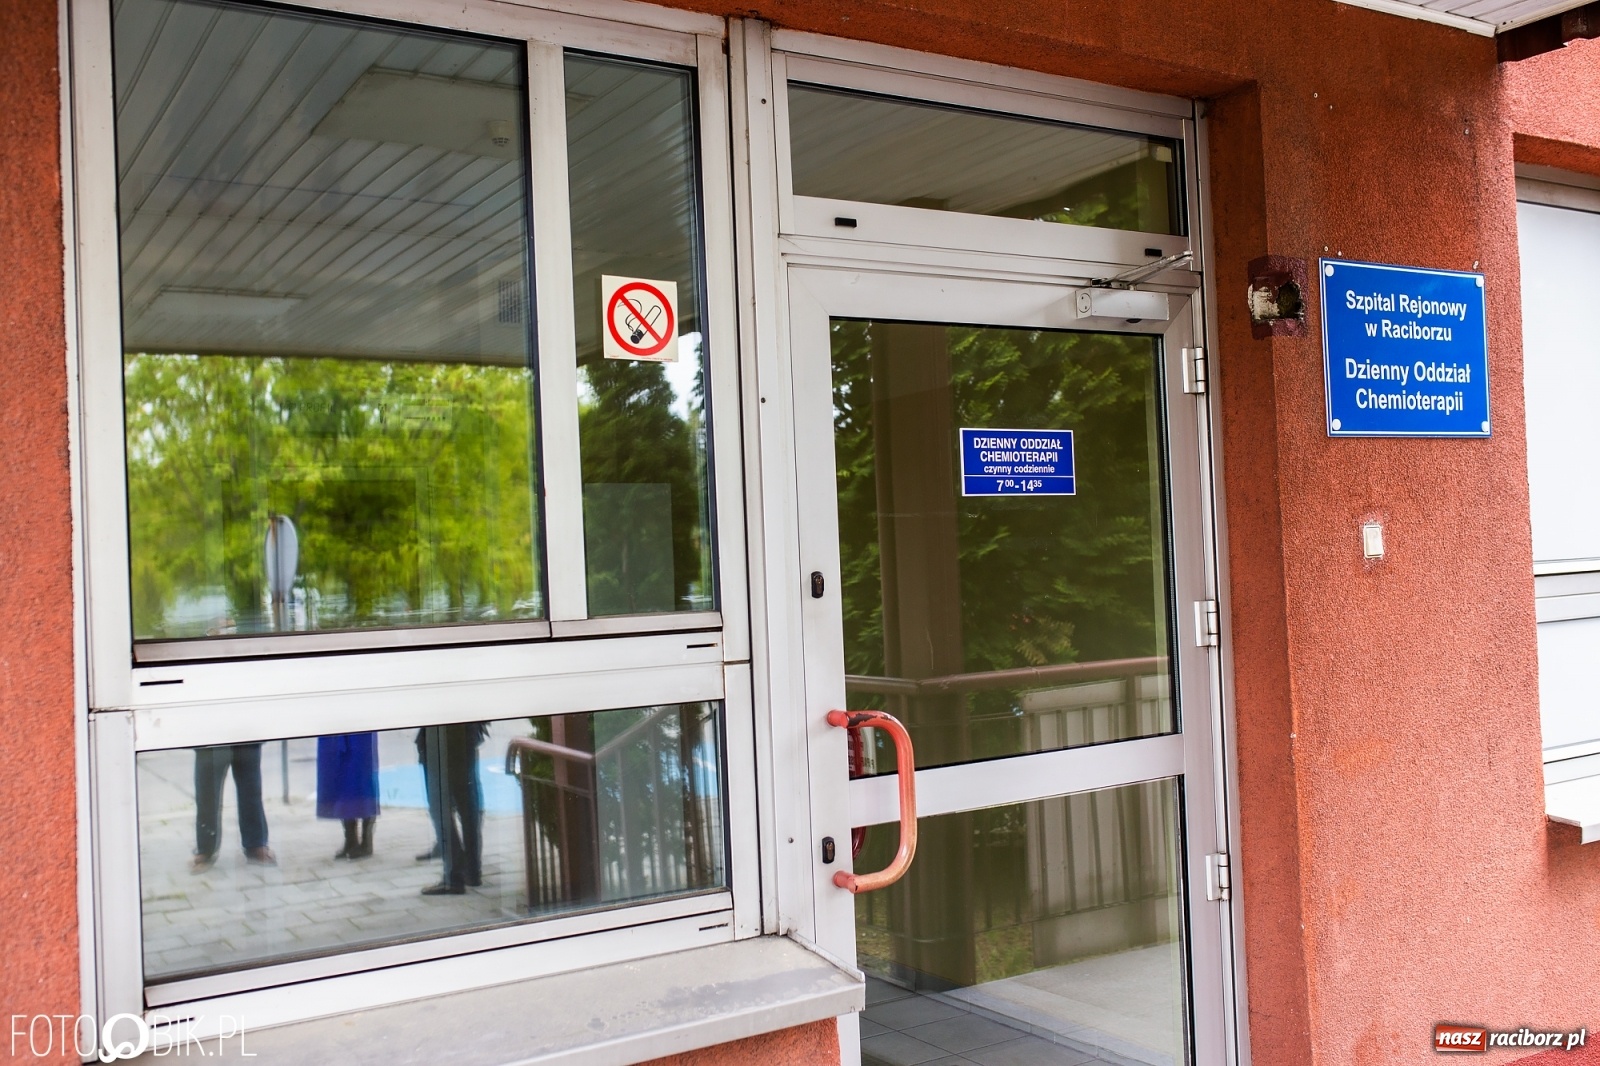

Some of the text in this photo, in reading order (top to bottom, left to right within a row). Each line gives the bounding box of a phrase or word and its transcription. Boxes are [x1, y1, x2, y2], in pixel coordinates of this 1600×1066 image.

[1345, 290, 1467, 321] Szpital Rejonowy
[1365, 319, 1452, 341] w Raciborzu
[1345, 358, 1471, 386] Dzienny Oddział
[1355, 388, 1463, 415] Chemioterapii
[973, 437, 1063, 450] DZIENNY ODDZIAŁ
[980, 451, 1058, 463] CHEMIOTERAPII
[983, 464, 1055, 475] czynny codziennie
